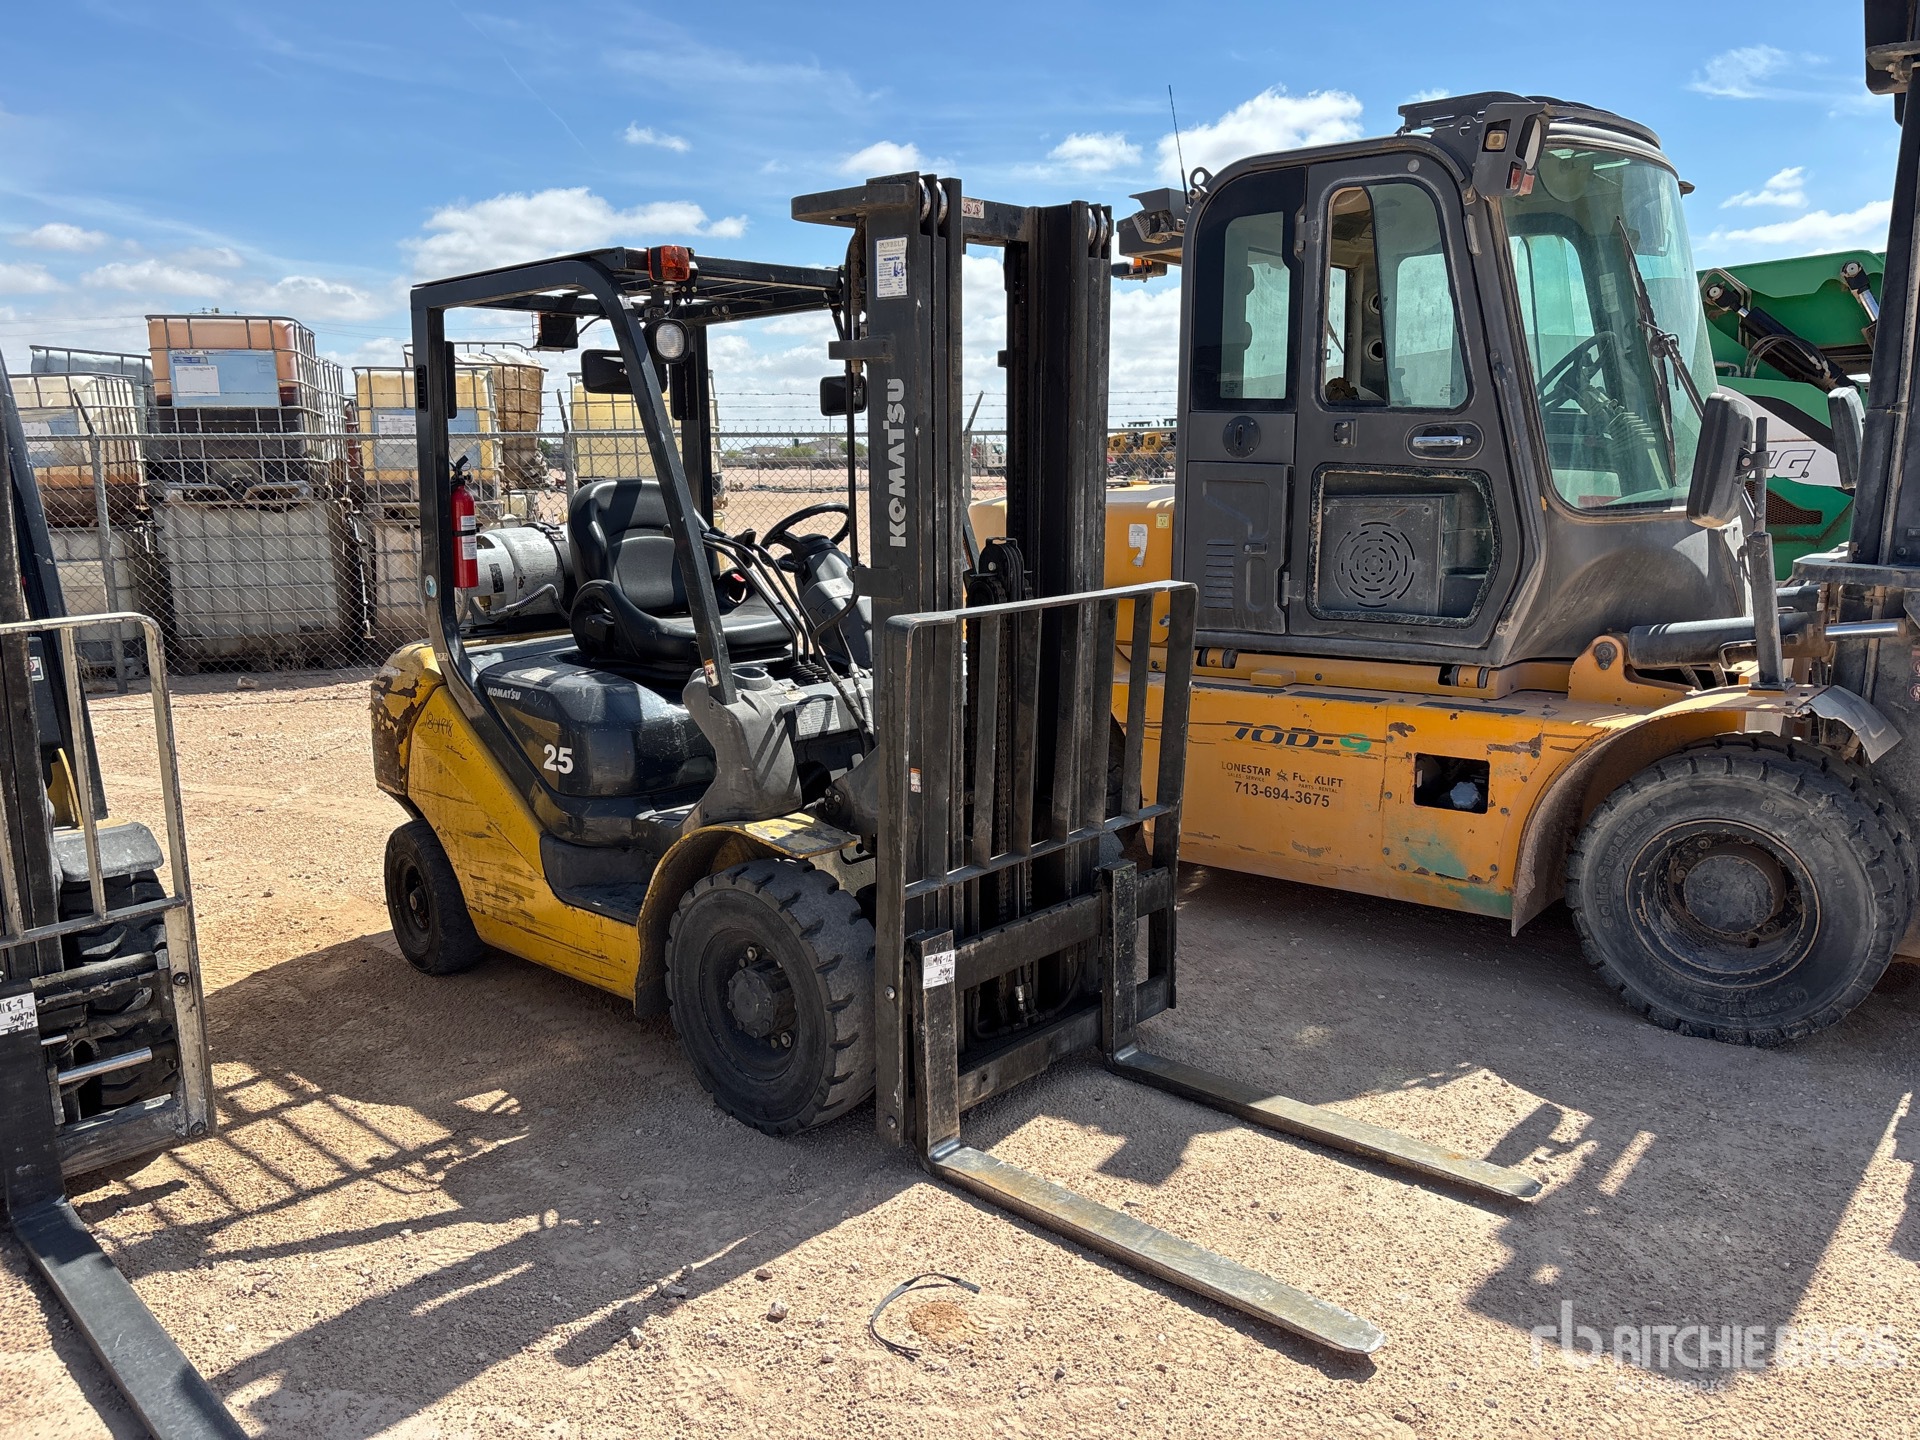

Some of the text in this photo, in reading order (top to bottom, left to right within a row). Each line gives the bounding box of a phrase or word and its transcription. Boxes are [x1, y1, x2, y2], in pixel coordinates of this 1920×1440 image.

[882, 378, 907, 548] KOMATSU
[487, 686, 522, 701] KOMATSU
[543, 743, 574, 774] 25
[1221, 761, 1271, 777] LONESTAR
[1234, 780, 1330, 808] 713-694-3675
[1245, 775, 1265, 783] SERVICE
[1318, 786, 1338, 794] RENTAL
